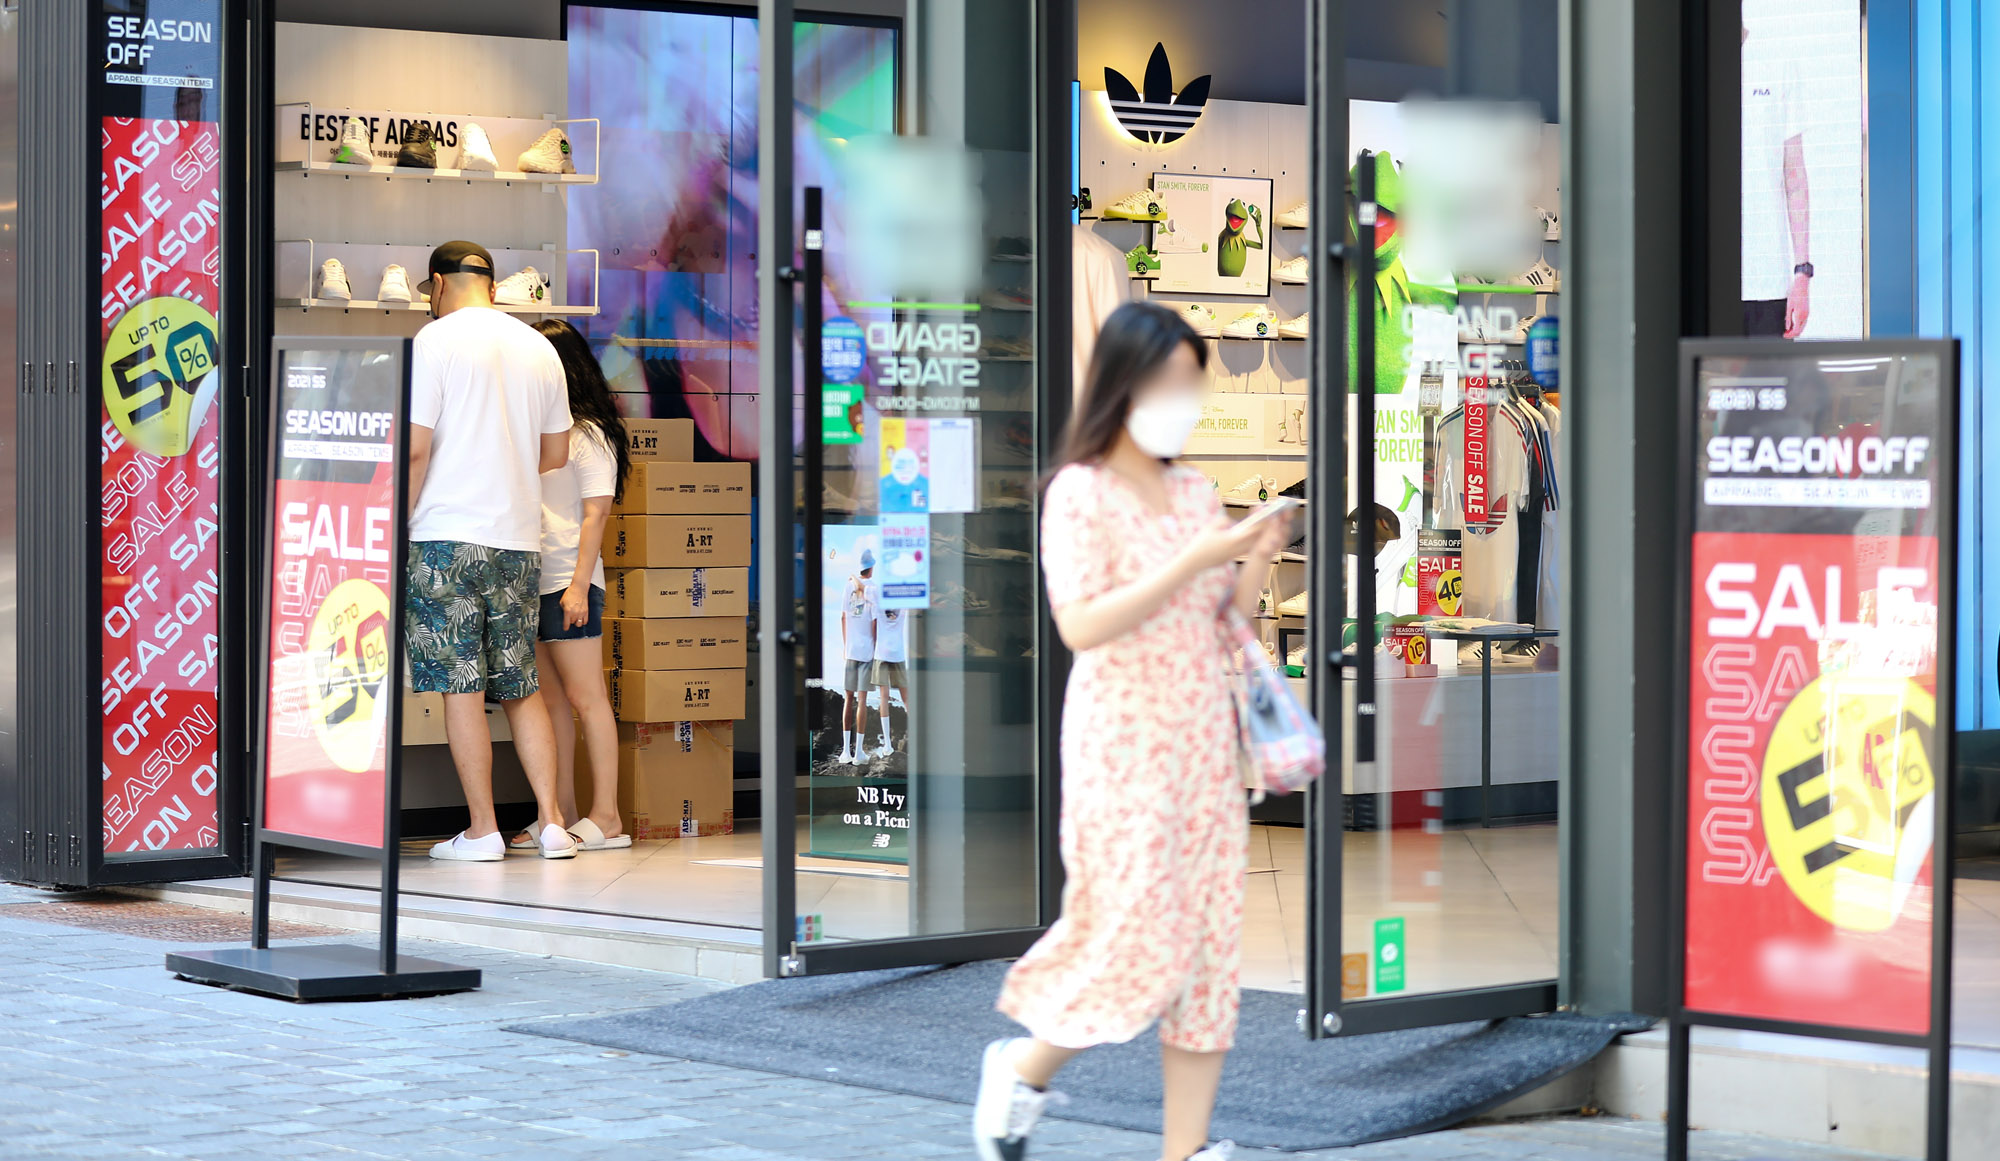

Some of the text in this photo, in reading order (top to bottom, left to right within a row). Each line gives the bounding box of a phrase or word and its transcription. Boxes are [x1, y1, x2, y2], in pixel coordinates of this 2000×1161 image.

[107, 16, 212, 43] SEASON
[107, 42, 154, 65] OFF
[108, 75, 145, 83] APPAREL
[152, 77, 186, 86] SEASON
[187, 79, 212, 87] ITEMS
[301, 114, 350, 142] BEST
[1157, 181, 1170, 190] STAN
[1187, 183, 1210, 192] FOREVER
[128, 316, 170, 345] UP TO
[287, 374, 311, 388] 2021
[286, 409, 393, 437] SEASON OFF
[1218, 418, 1248, 430] FOREVER
[1374, 409, 1396, 434] AN
[631, 435, 658, 449] A-RT
[1467, 376, 1484, 515] SEASON OFF SALE
[1706, 435, 1930, 475] SEASON OFF
[108, 470, 199, 575] SALE
[281, 502, 391, 562] SALE
[170, 502, 219, 572] SA
[686, 533, 713, 547] A-RT
[1418, 539, 1462, 547] SEASON OFF
[1419, 557, 1461, 572] SALE
[105, 565, 160, 638] OFF
[1385, 638, 1408, 647] SALE
[1409, 641, 1426, 659] 10
[684, 687, 711, 702] A-RT
[112, 681, 169, 756] OFF
[856, 786, 905, 811] NB Ivy
[843, 813, 861, 825] on
[863, 814, 873, 826] a
